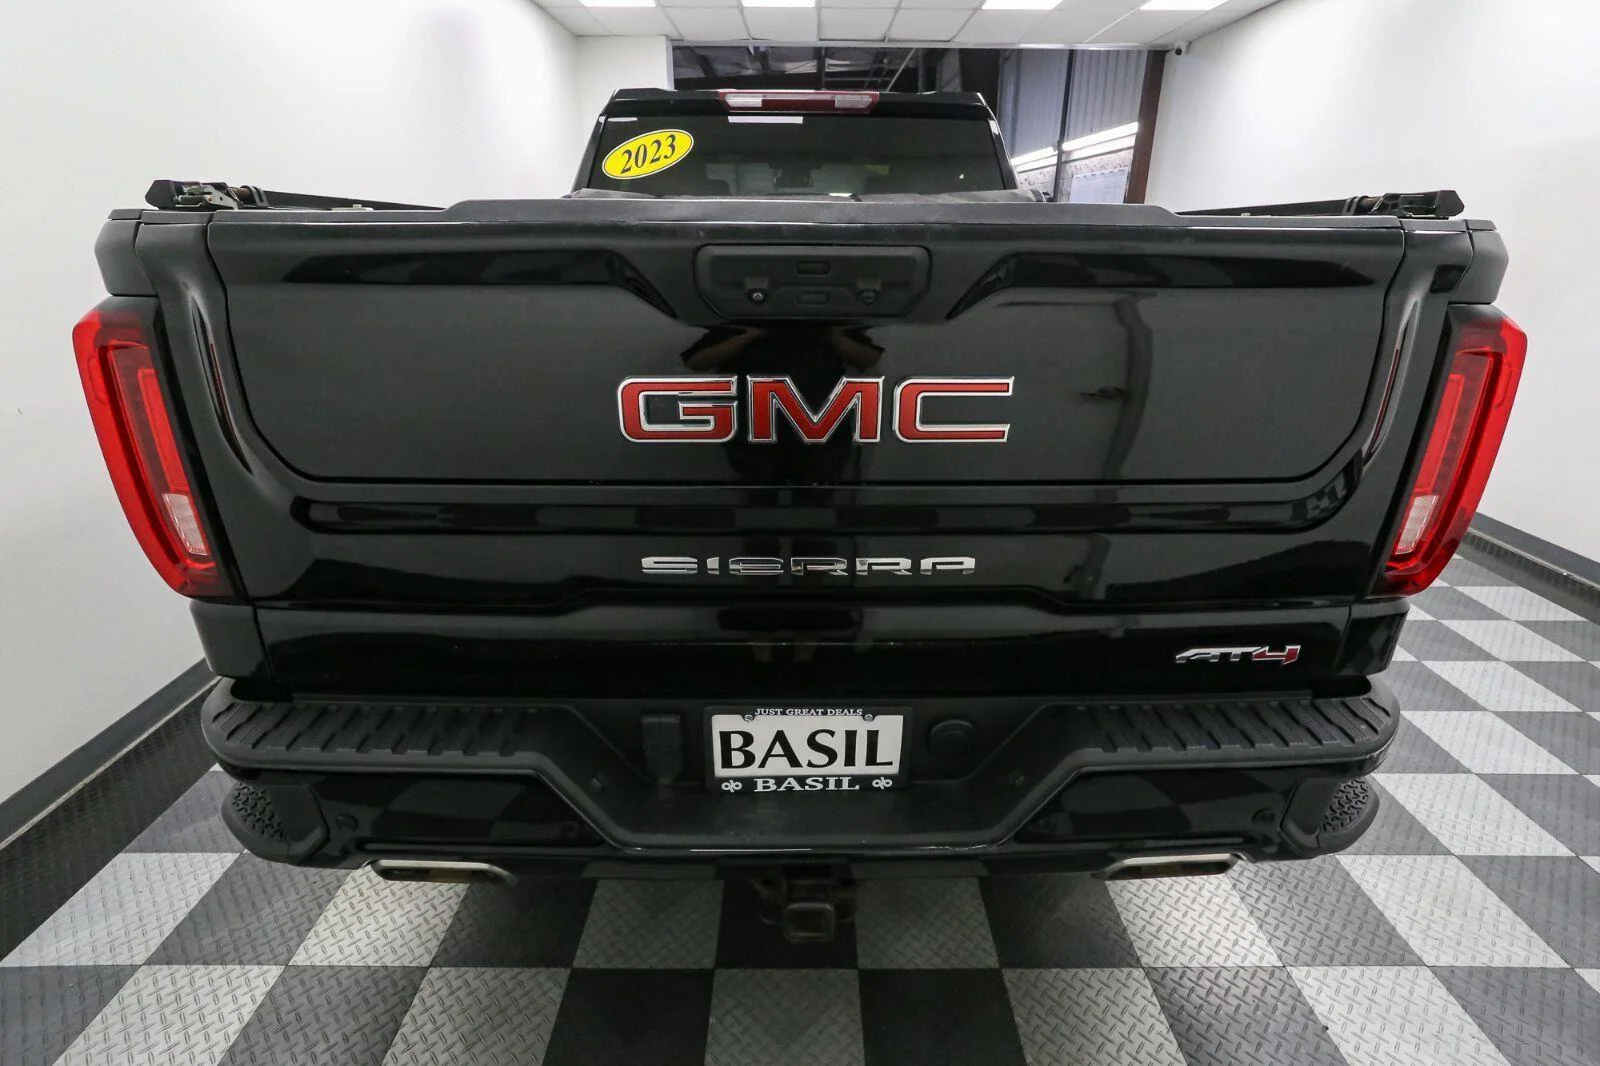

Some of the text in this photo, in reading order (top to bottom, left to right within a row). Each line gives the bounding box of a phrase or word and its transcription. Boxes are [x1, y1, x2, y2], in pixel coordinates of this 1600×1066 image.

[620, 134, 676, 174] 2023
[617, 375, 1014, 443] GMC
[641, 556, 976, 575] SIERRA
[1175, 645, 1301, 665] AT4
[755, 708, 863, 716] JUST GREAT DEALS
[719, 729, 893, 769] BASIL
[754, 777, 860, 792] BASIL
